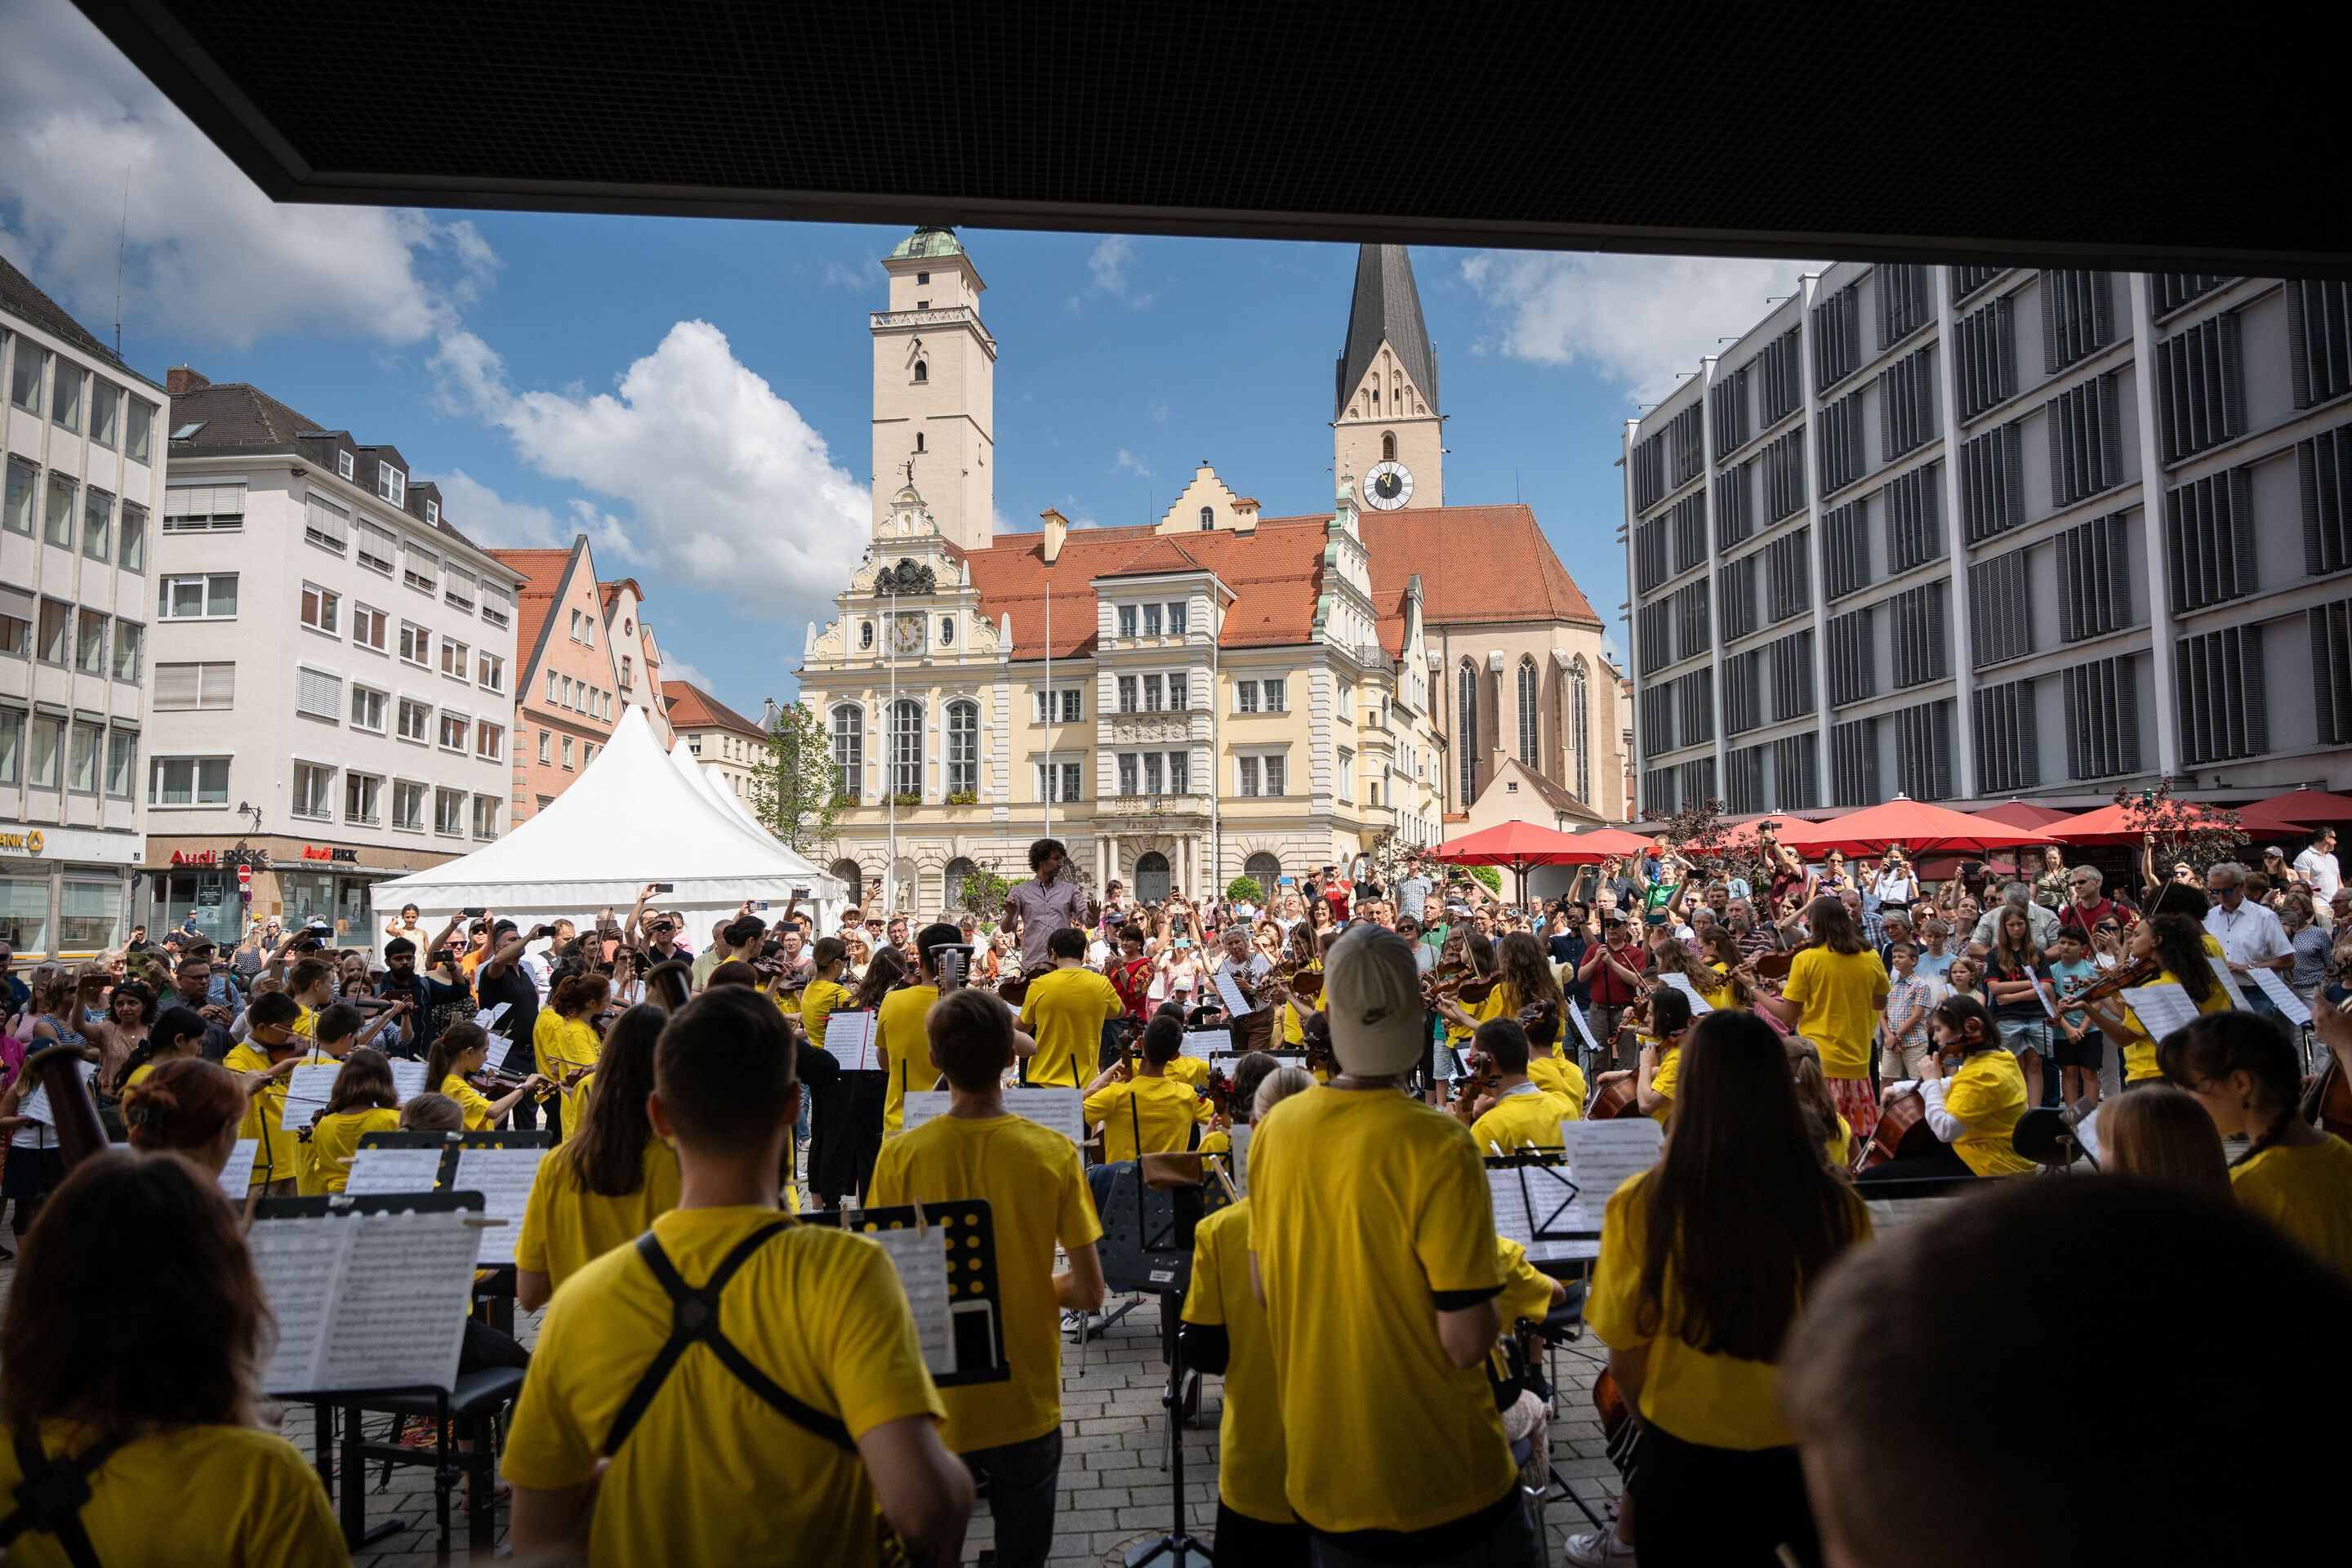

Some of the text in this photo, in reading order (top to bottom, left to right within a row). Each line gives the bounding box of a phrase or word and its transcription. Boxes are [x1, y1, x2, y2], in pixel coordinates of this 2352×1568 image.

[1126, 821, 1165, 830] RATHAUS
[170, 849, 269, 864] Audi BKK
[301, 845, 332, 860] Audi
